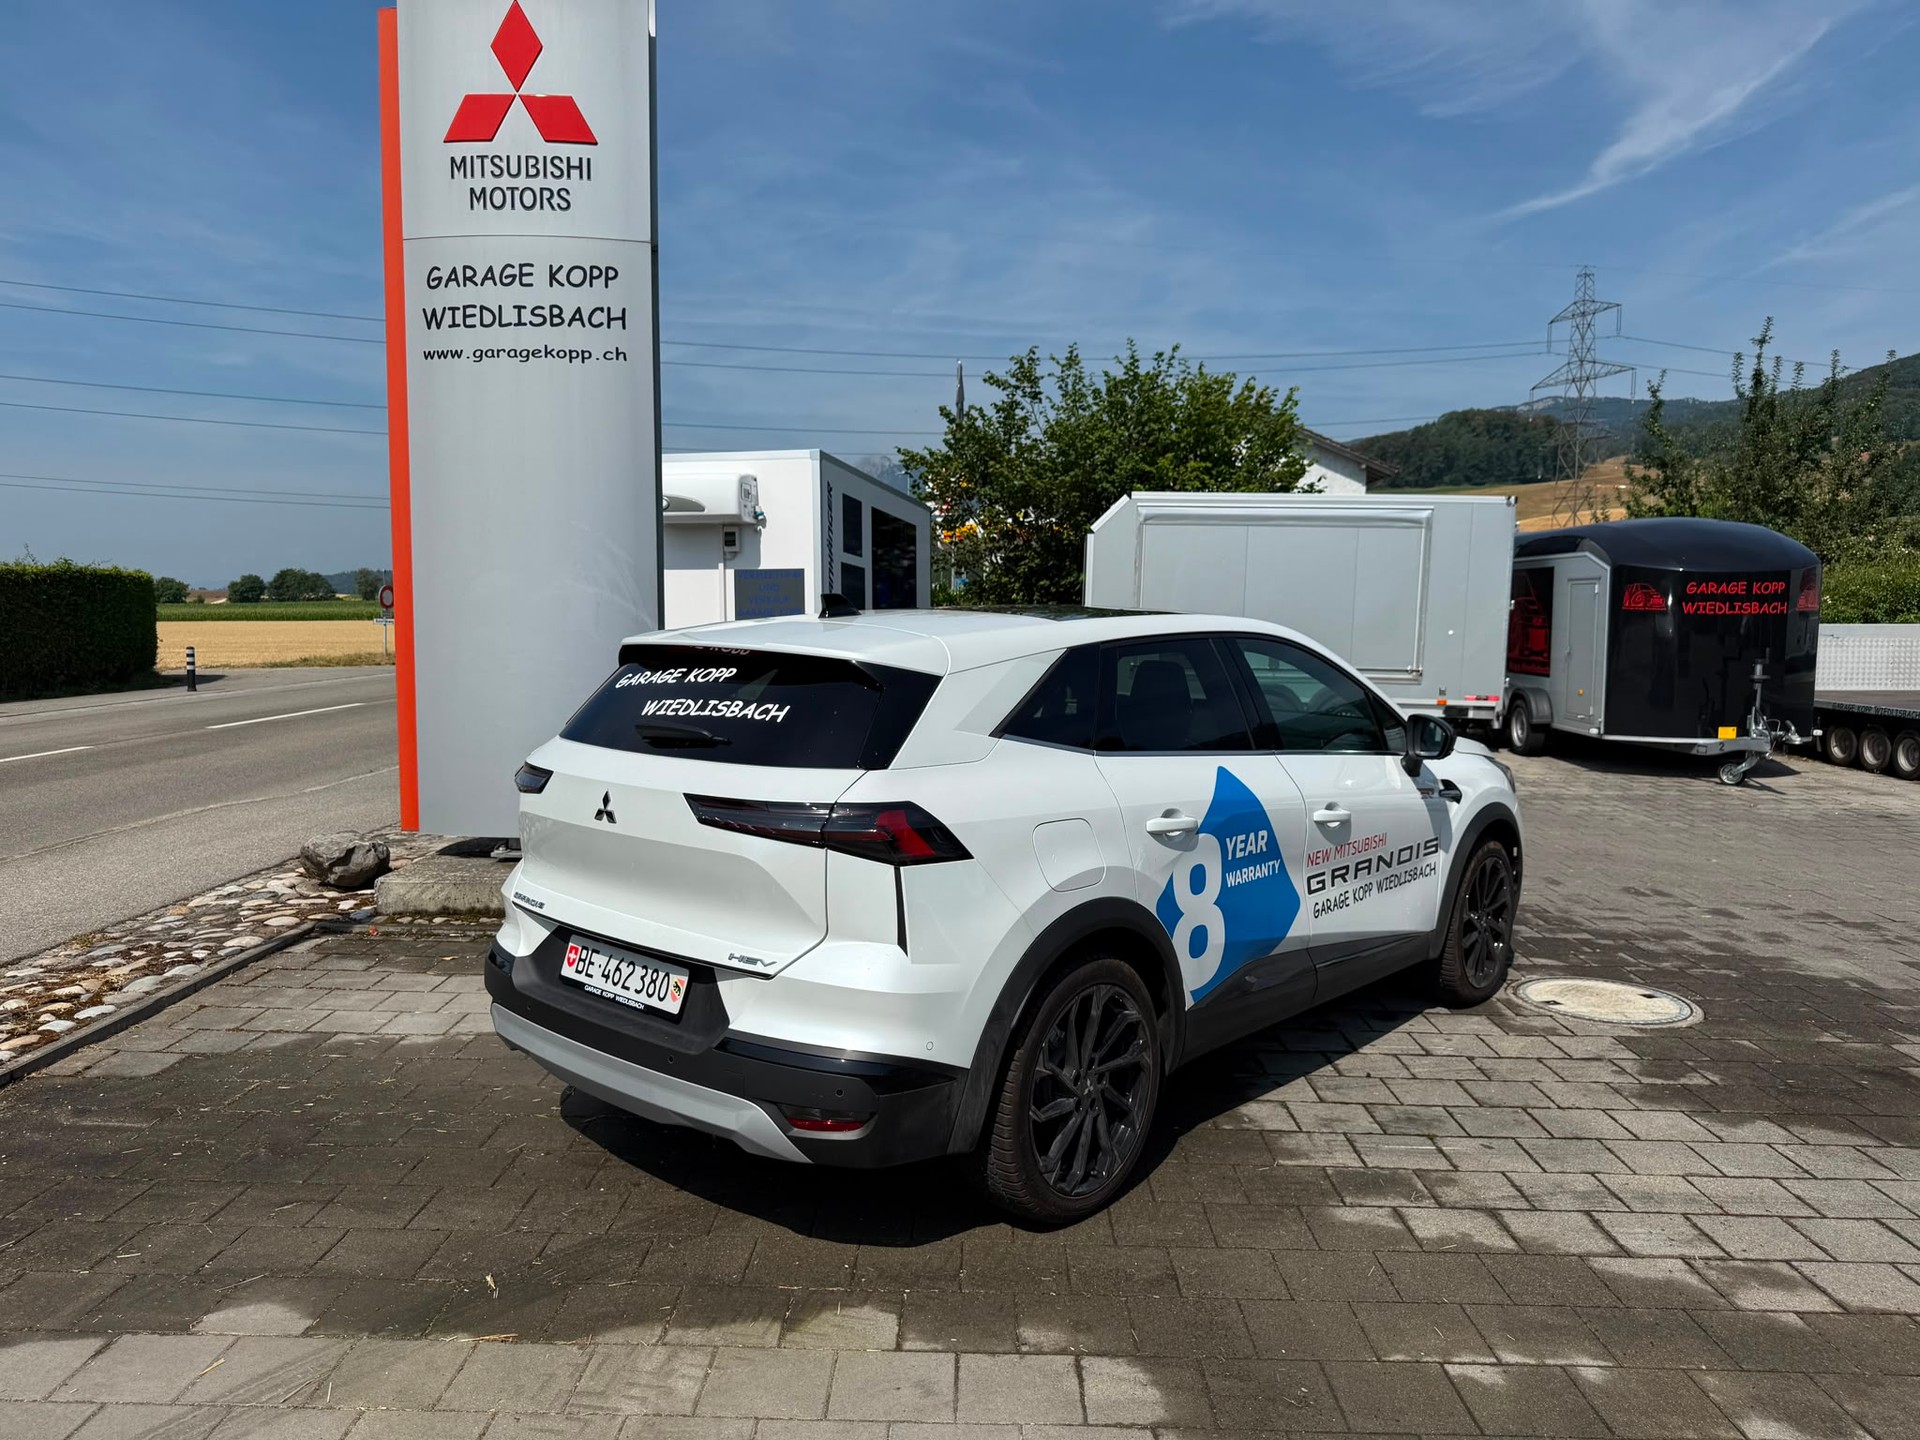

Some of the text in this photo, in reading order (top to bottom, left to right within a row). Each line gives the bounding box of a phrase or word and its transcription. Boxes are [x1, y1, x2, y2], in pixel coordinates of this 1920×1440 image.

[450, 155, 593, 181] MITSUBISHI
[469, 186, 572, 211] MOTORS
[426, 263, 620, 290] GARAGE KOPP
[422, 304, 627, 331] WIEDLISBACH
[423, 344, 628, 364] www.garagekopp.ch
[1686, 581, 1786, 595] GARAGE KOPP
[1682, 601, 1788, 615] WIEDLISBACH
[615, 667, 738, 689] GARAGE KOPP
[640, 698, 791, 723] WIEDLISBACH
[1225, 830, 1268, 861] YEAR
[1306, 832, 1388, 868] NEW MITSUBISHI
[1225, 858, 1281, 888] WARRANTY
[1306, 836, 1439, 896] GRANDIS
[1313, 861, 1437, 919] GARAGE KOPP WIEDLISBACH
[1172, 832, 1226, 992] 8
[727, 952, 778, 967] HEV
[584, 984, 603, 996] GARAGE
[601, 991, 615, 1000] KOPP
